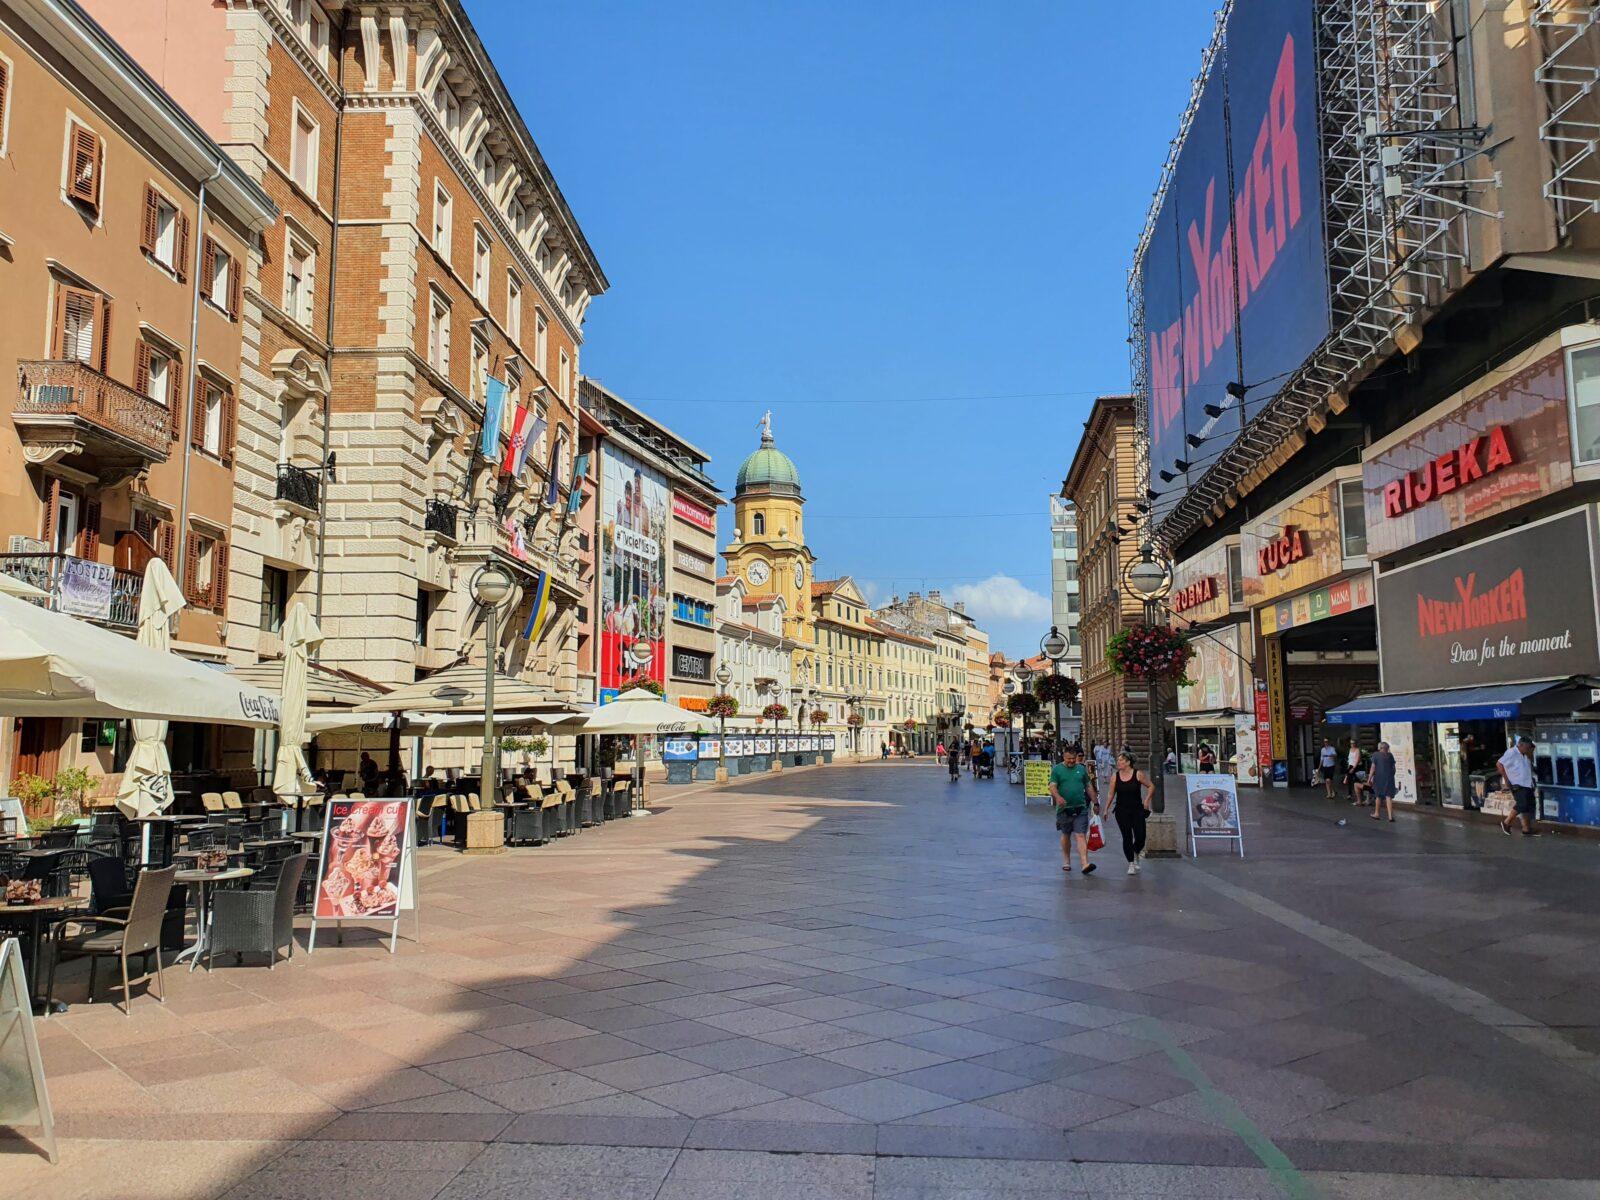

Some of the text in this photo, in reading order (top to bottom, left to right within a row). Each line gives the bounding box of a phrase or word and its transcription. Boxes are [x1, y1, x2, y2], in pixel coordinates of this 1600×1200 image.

[1384, 425, 1513, 518] RIJEKA
[1257, 526, 1304, 576] KUĆA
[66, 560, 111, 582] HOSTEL
[1175, 578, 1212, 613] ROBNA
[1450, 629, 1572, 667] Dress for the moment.
[333, 804, 348, 815] Ice
[350, 804, 384, 815] Cream
